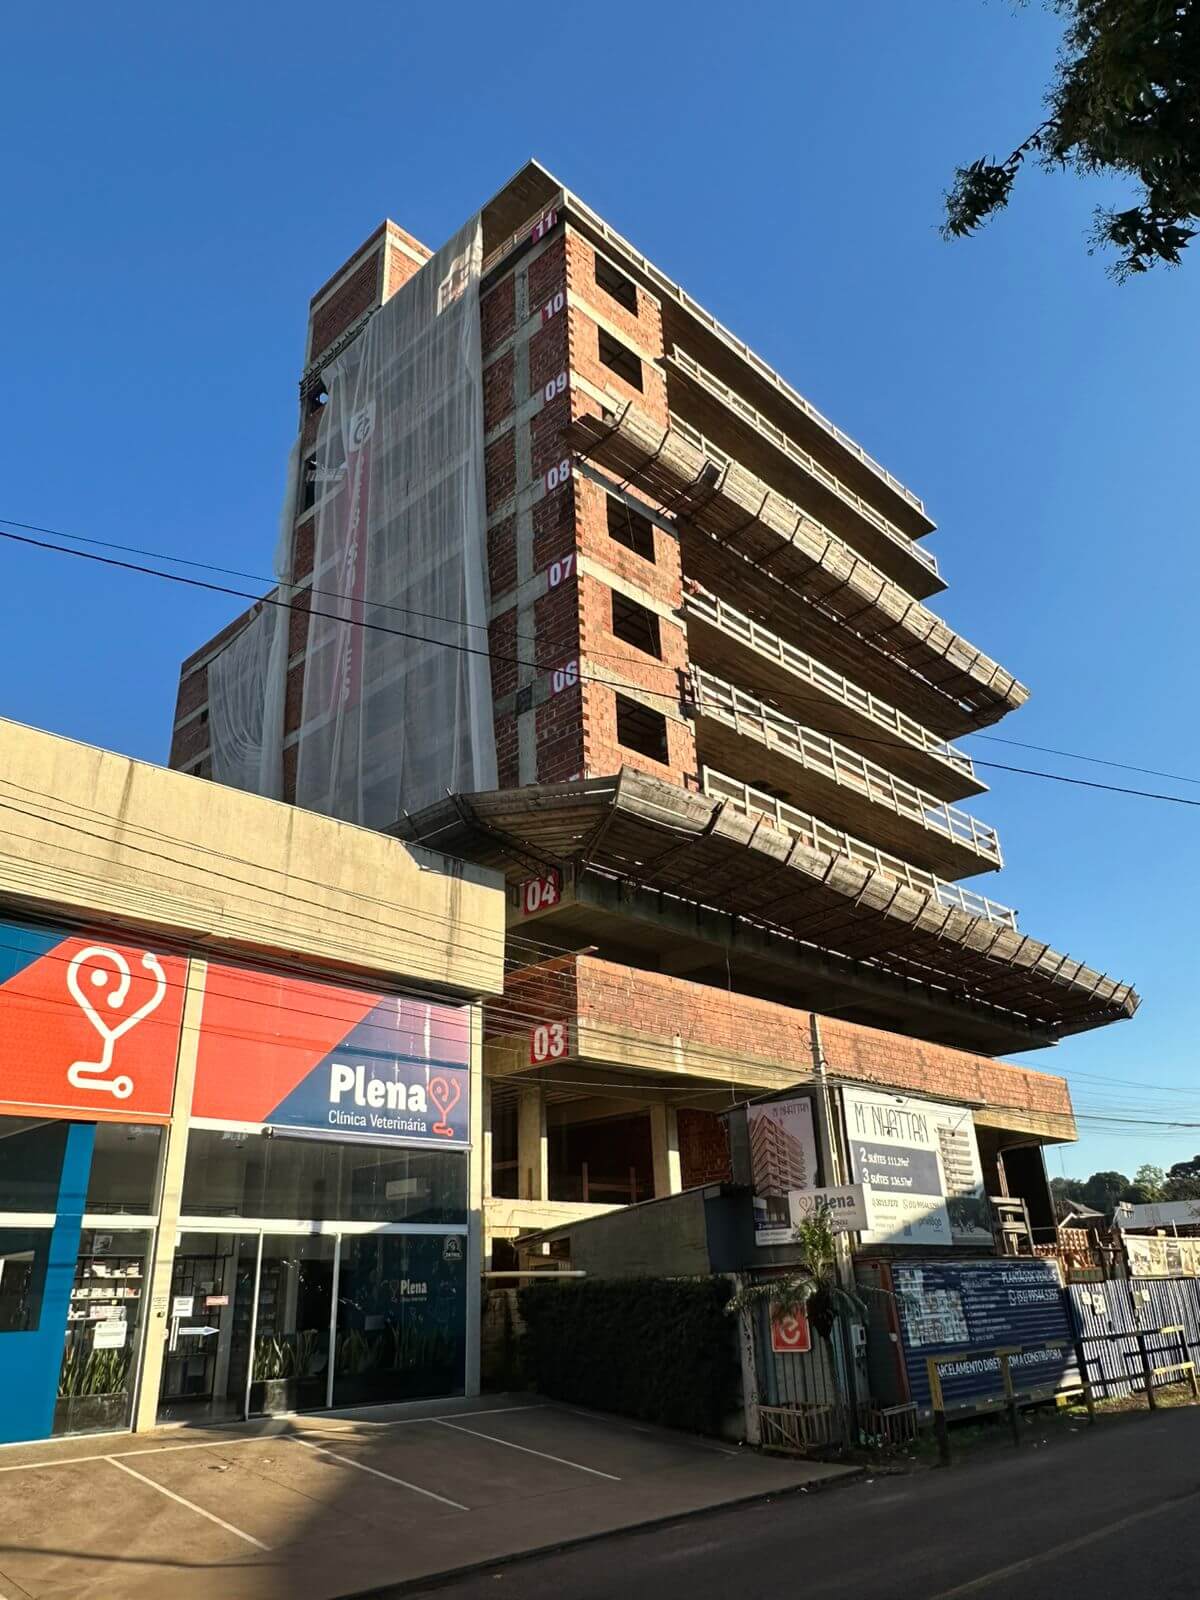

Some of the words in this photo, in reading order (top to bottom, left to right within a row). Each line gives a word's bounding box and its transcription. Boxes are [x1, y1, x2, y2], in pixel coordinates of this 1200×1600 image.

[536, 213, 553, 239] 11
[546, 291, 564, 320] 10
[545, 371, 567, 401] 09
[548, 458, 570, 489] 08
[550, 553, 574, 586] 07
[553, 660, 577, 693] 06
[526, 876, 556, 912] 04
[534, 1023, 564, 1061] 03
[330, 1063, 427, 1112] Plena
[328, 1109, 367, 1126] Clínica
[369, 1113, 427, 1132] Veterinária
[855, 1103, 929, 1142] MNHATTAN
[860, 1147, 867, 1162] 2
[862, 1167, 870, 1183] 3
[815, 1193, 855, 1211] Plena
[400, 1279, 427, 1295] Plena
[937, 1359, 984, 1377] ARCELAMENTO
